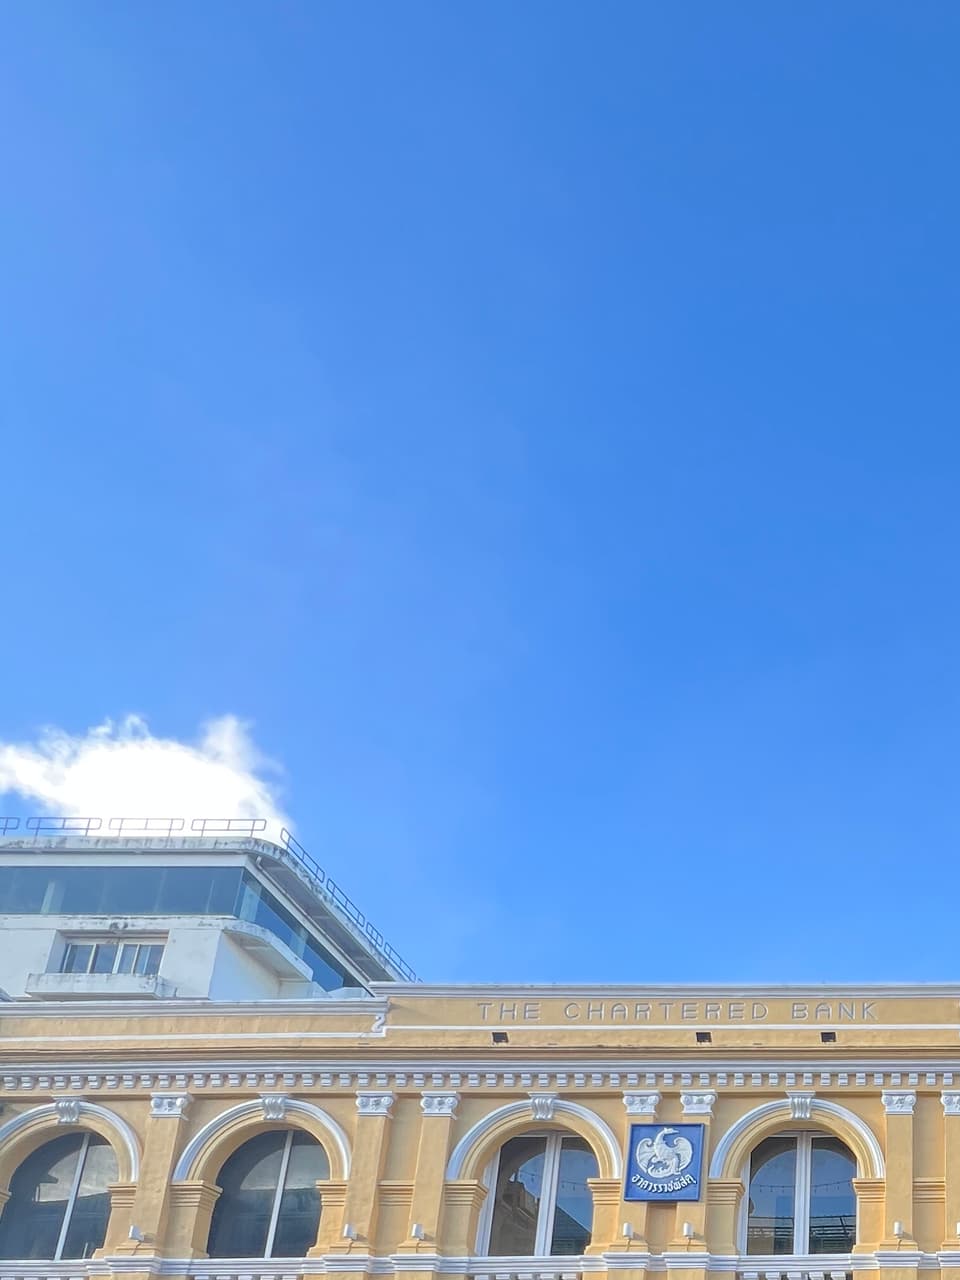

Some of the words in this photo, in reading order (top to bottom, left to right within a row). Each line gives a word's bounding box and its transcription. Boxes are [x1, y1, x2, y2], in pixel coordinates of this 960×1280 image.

[477, 1002, 542, 1020] THE
[563, 1002, 770, 1021] CHARTERED
[791, 1002, 879, 1021] BANK
